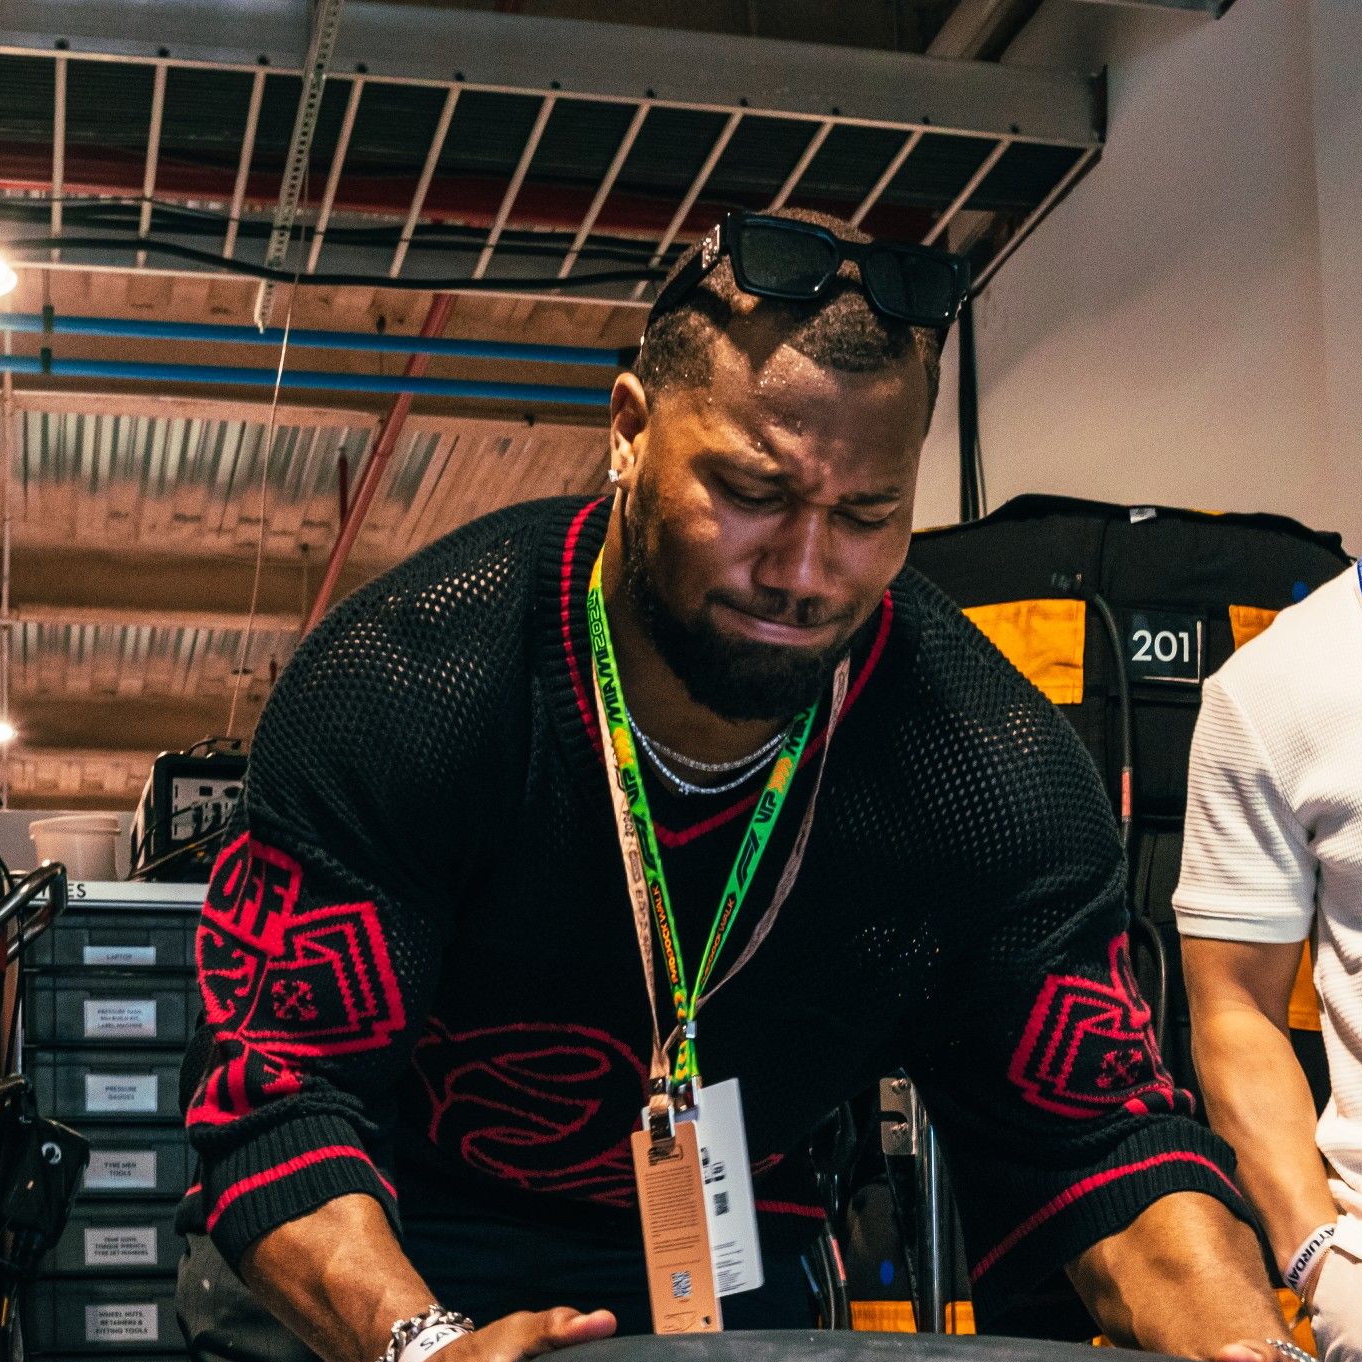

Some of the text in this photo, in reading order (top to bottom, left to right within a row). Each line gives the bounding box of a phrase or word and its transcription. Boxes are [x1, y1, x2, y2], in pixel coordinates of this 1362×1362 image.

[1130, 629, 1190, 663] 201
[754, 789, 778, 824] VIP
[1286, 1227, 1335, 1290] ATURDAY
